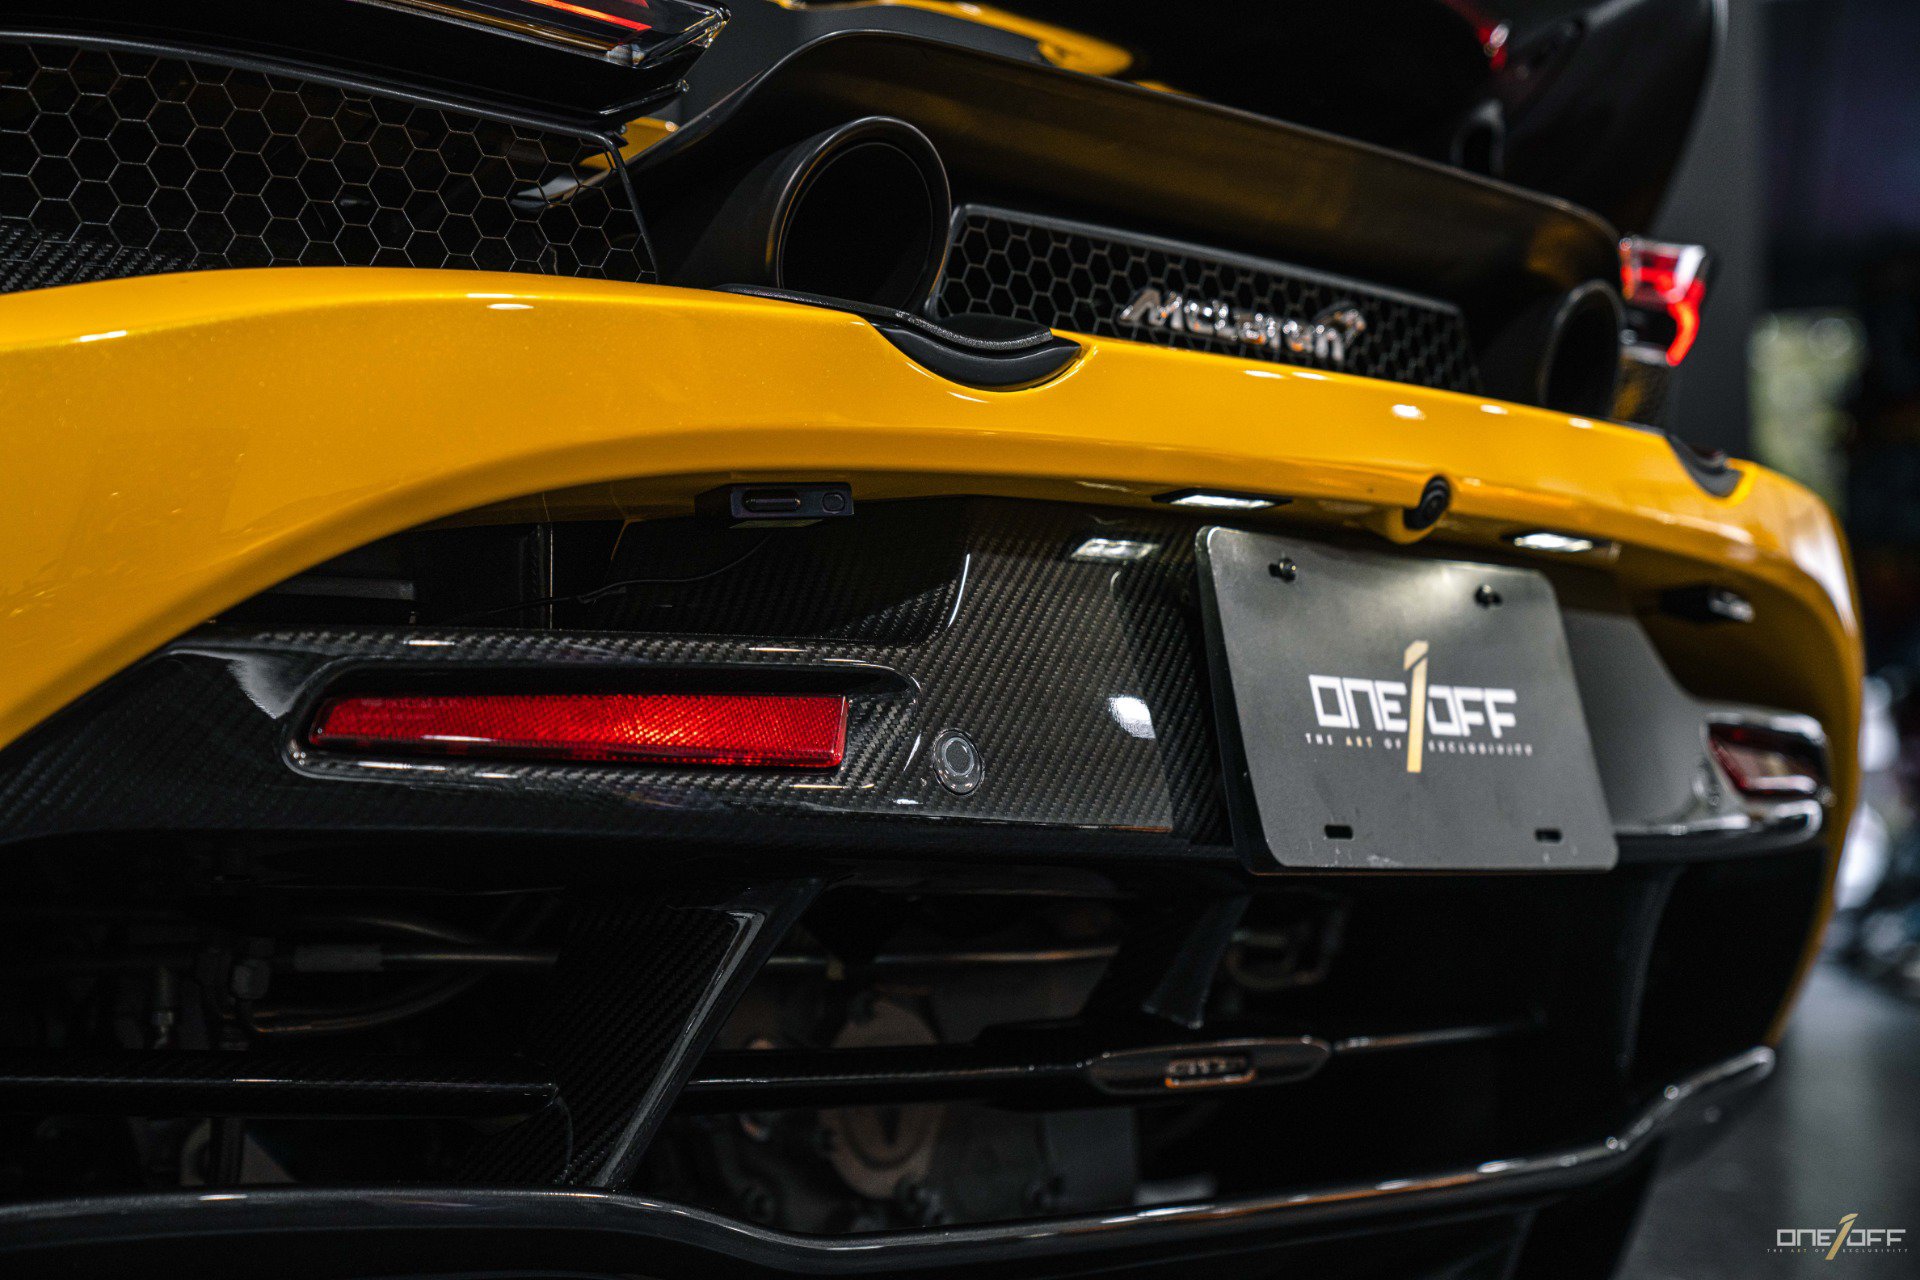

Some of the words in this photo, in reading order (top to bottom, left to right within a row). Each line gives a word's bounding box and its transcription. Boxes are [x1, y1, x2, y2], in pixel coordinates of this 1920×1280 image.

[1304, 732, 1334, 746] THE
[1345, 735, 1373, 749] ART
[1383, 737, 1402, 750] OF
